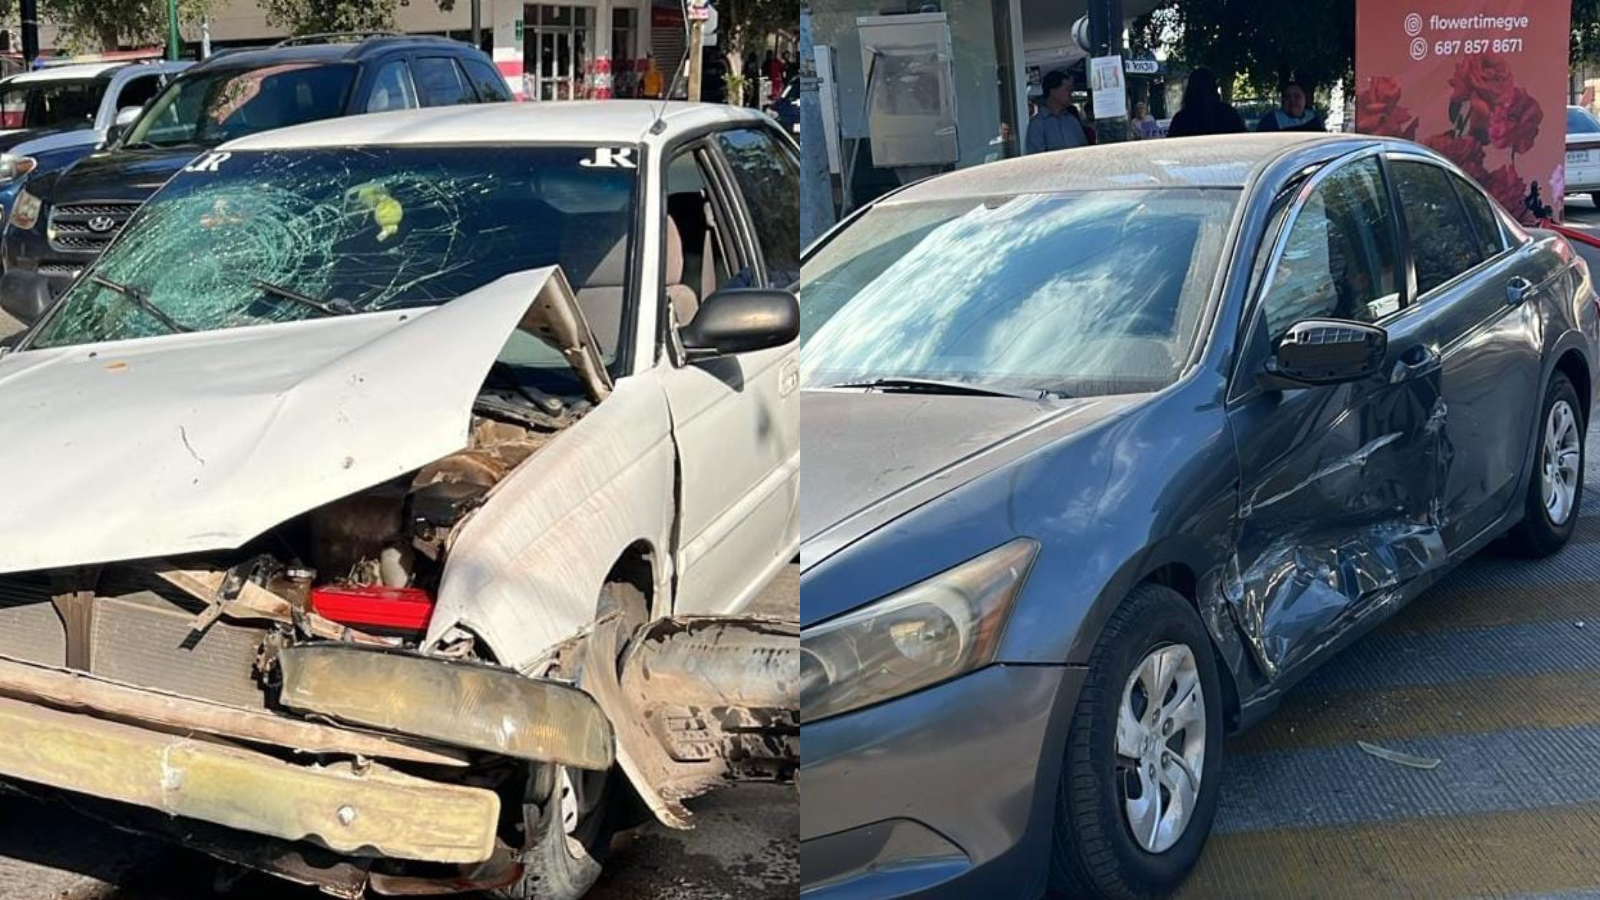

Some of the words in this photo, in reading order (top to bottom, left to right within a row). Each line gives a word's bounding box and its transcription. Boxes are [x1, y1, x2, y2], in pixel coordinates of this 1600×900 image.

[1430, 14, 1528, 31] flowertimegve
[1435, 40, 1461, 55] 687
[1464, 39, 1489, 54] 857
[1493, 38, 1522, 53] 8671
